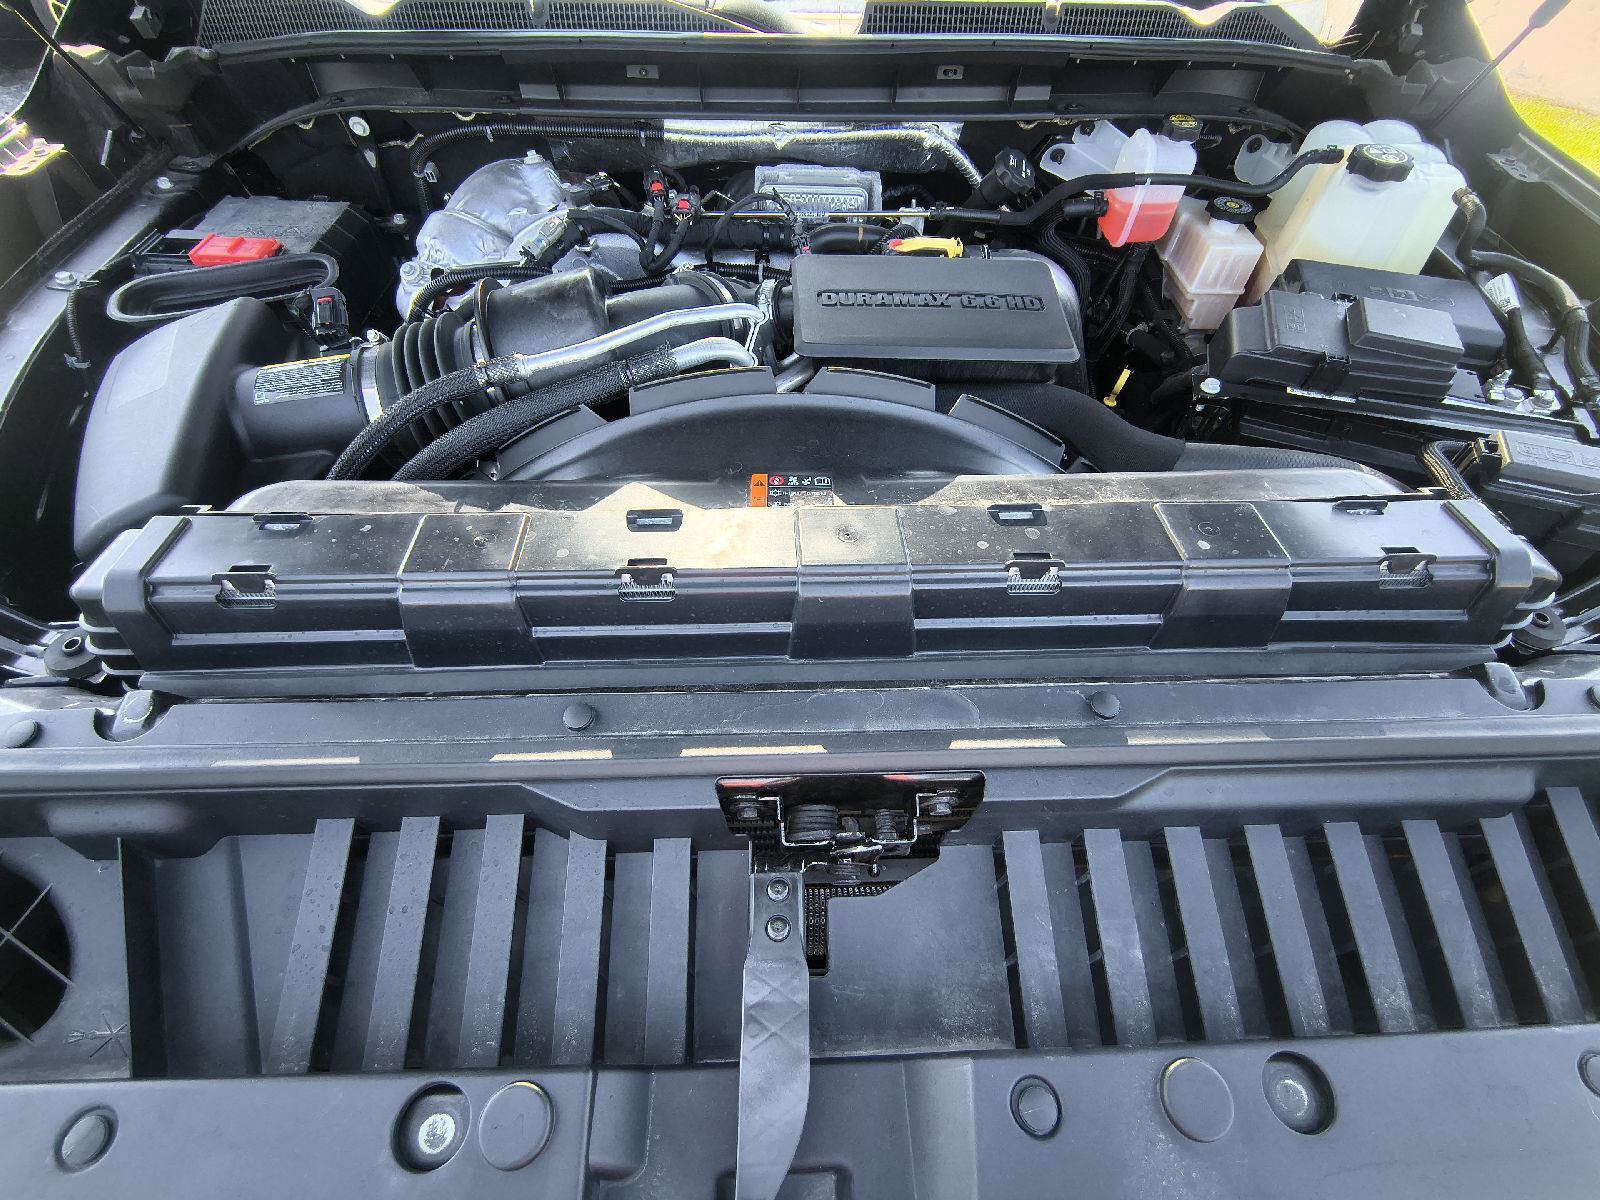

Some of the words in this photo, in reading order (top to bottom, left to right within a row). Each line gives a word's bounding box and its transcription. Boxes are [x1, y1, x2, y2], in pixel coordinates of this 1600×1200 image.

[821, 291, 951, 307] DURAMAX
[960, 293, 1001, 309] 6.6
[1005, 294, 1043, 312] HD
